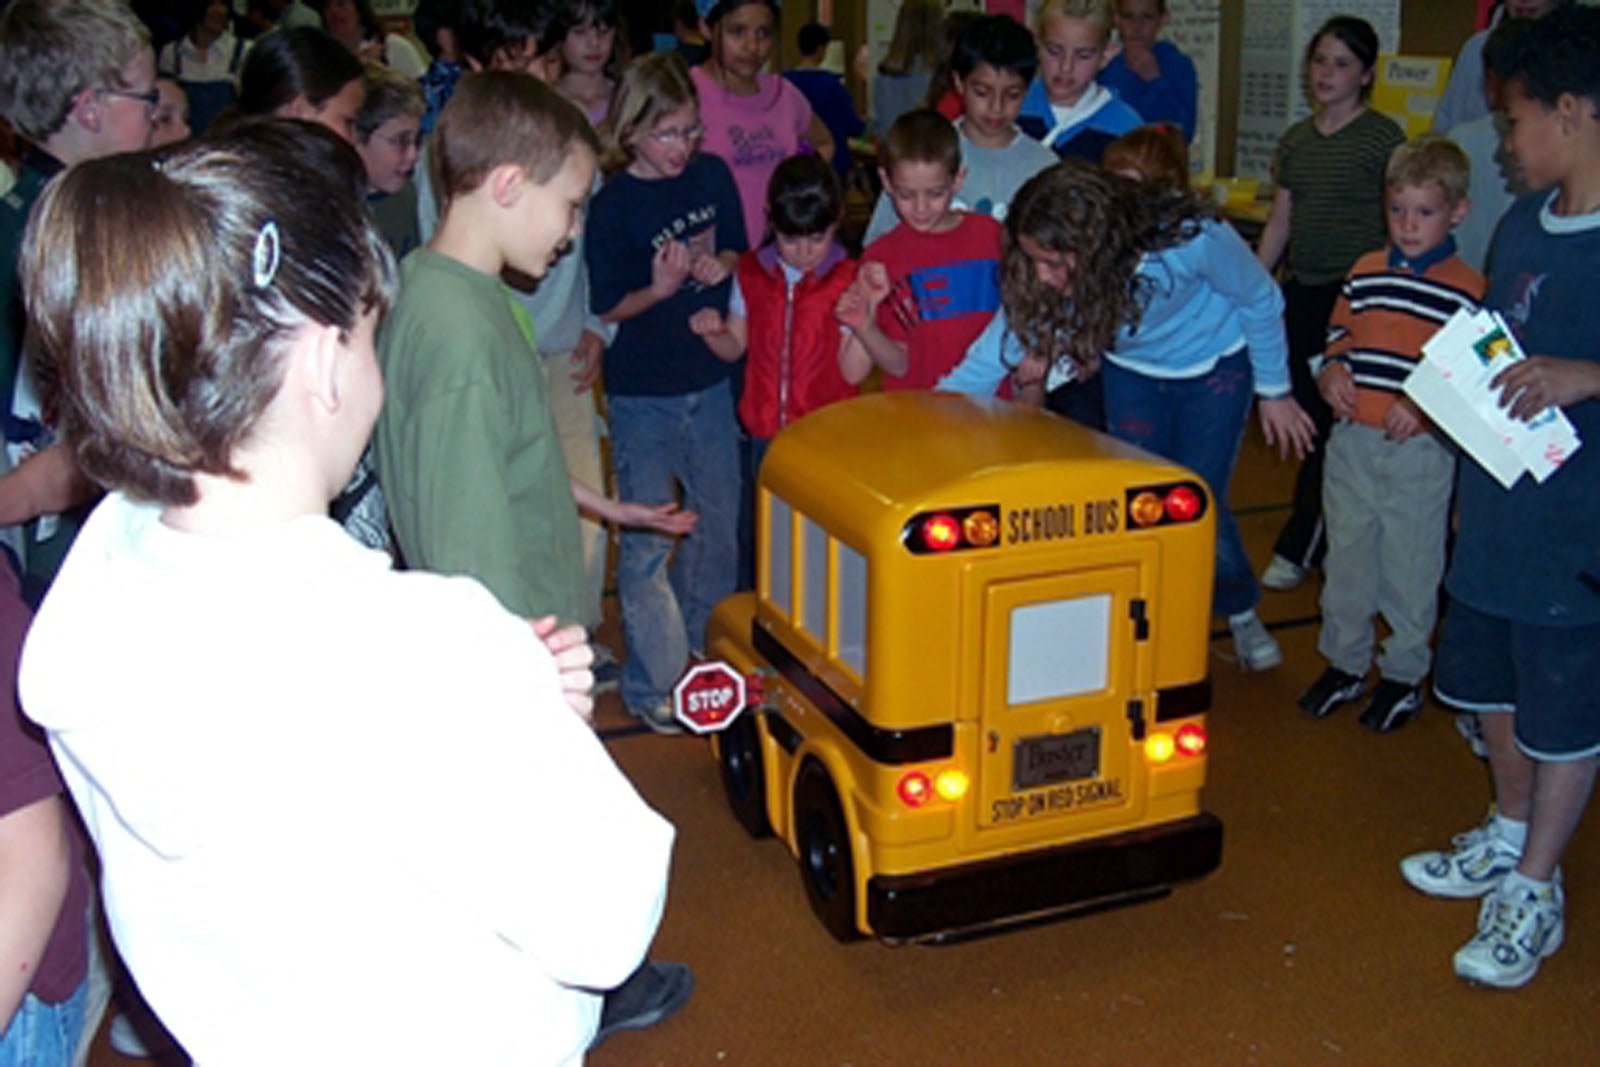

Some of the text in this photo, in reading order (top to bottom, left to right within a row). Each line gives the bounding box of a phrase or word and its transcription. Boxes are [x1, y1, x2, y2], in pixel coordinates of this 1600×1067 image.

[1387, 62, 1431, 81] Power
[1008, 499, 1118, 544] SCHOOL BUS
[688, 687, 733, 712] STOP
[993, 777, 1122, 822] STOP ON RED SIGNAL
